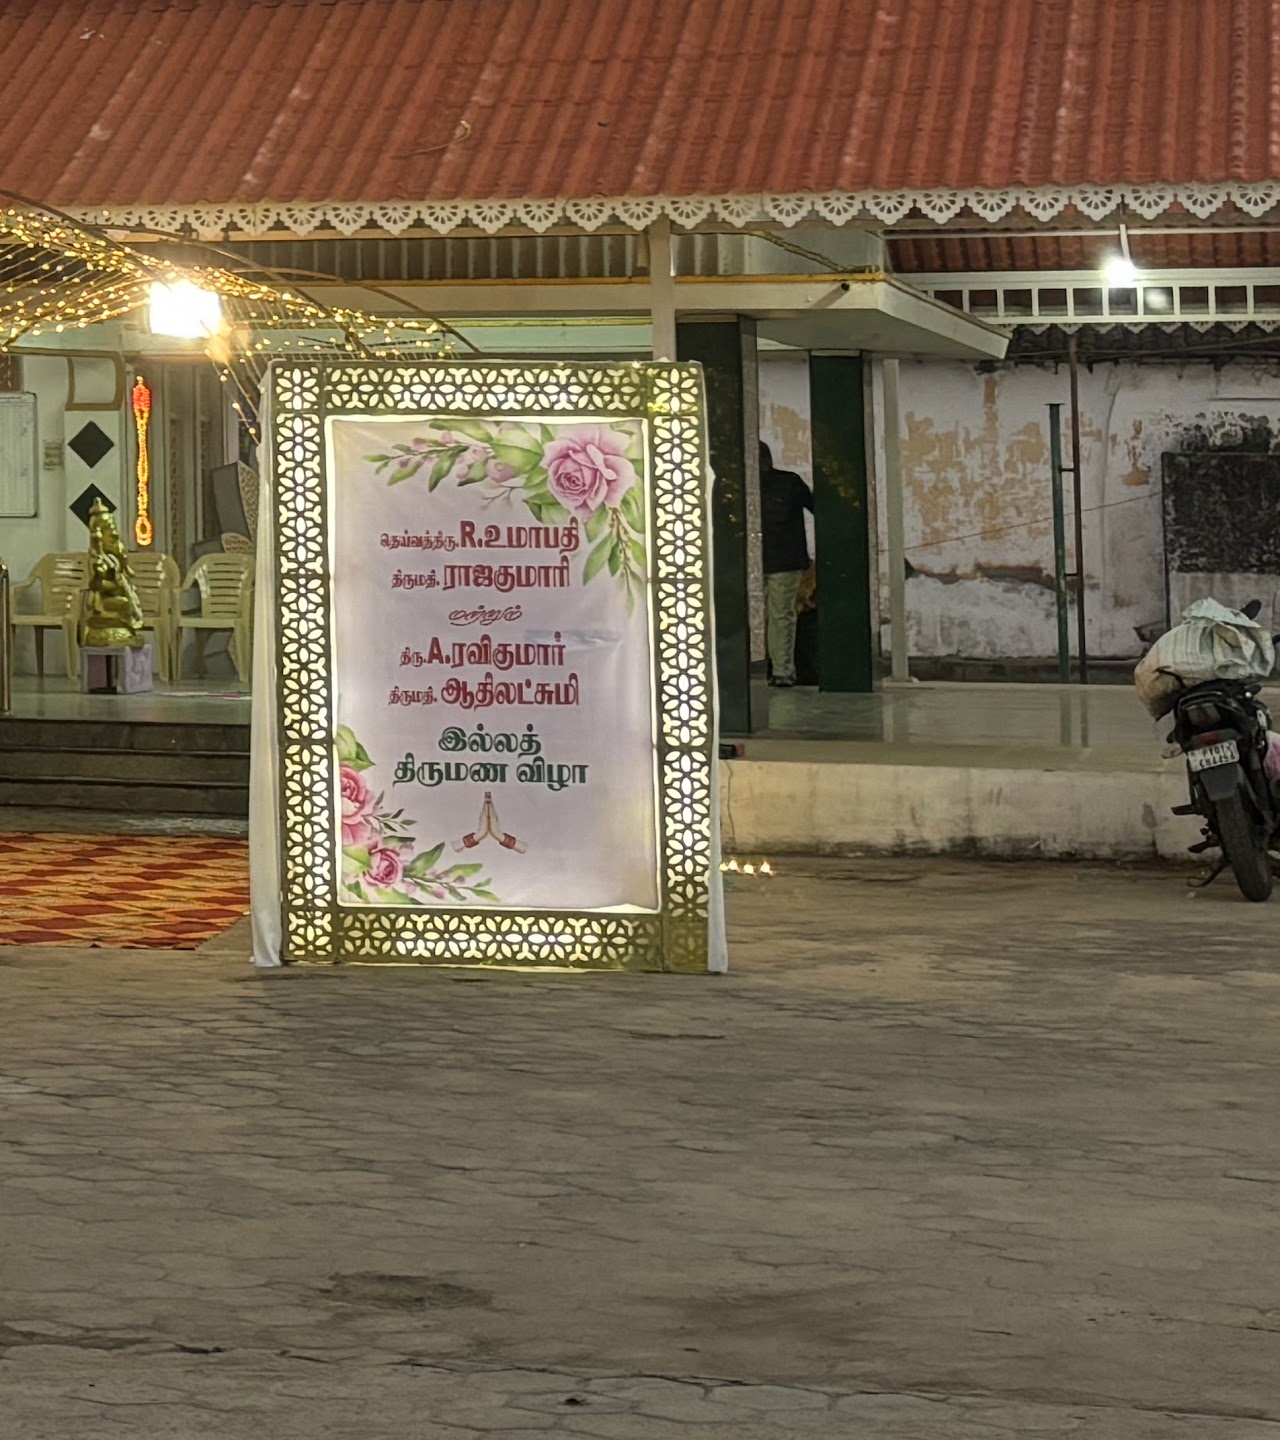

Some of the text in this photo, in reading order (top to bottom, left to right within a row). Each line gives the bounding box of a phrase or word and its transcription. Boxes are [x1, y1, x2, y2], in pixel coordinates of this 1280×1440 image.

[442, 555, 570, 593] ராஜகுமாரி
[448, 604, 523, 626] மற்றும்
[441, 671, 579, 711] ஆதிலட்சுமி
[438, 723, 542, 758] இல்லத்
[392, 752, 589, 791] திருமண விழா
